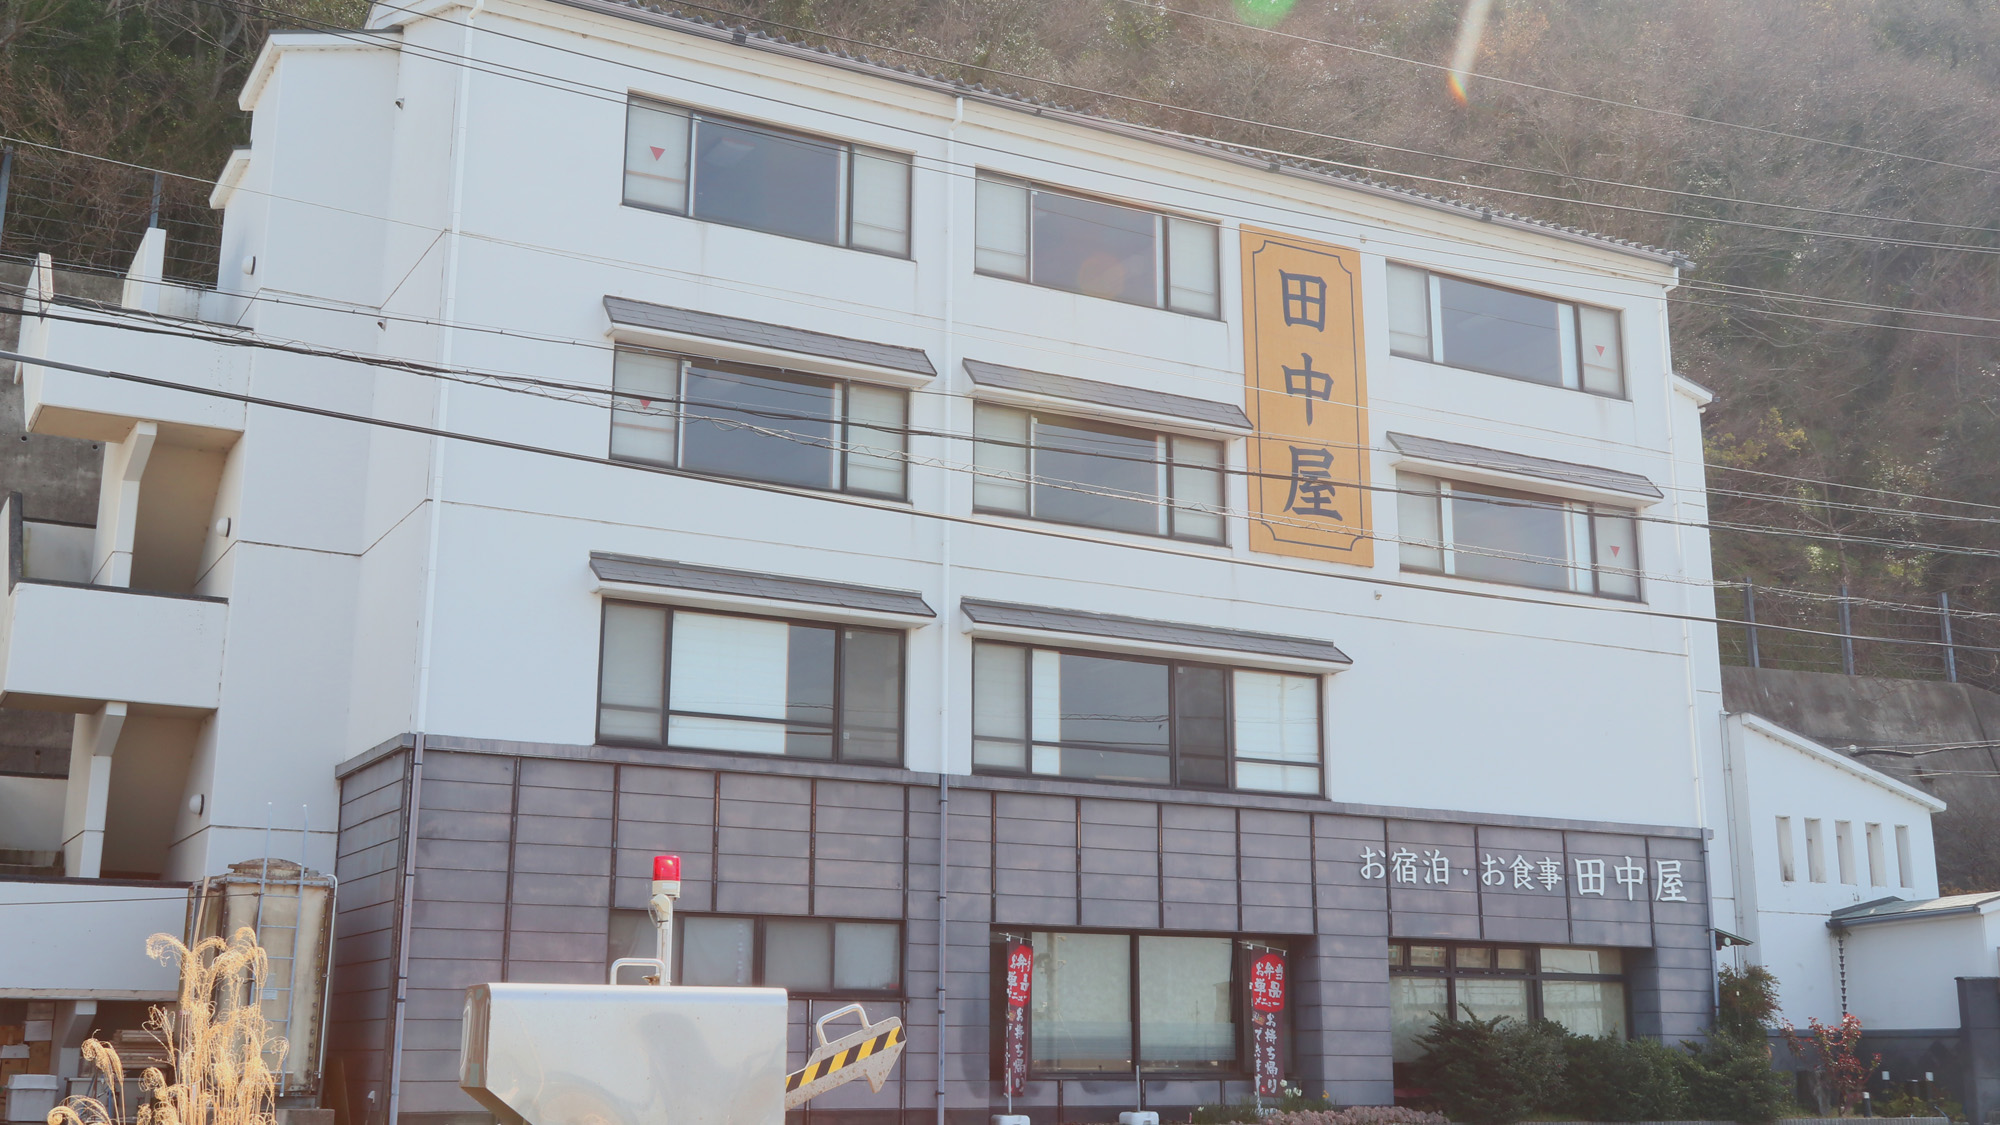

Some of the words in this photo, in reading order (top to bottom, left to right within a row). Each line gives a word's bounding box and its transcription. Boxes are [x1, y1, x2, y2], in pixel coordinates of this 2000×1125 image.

[1279, 269, 1343, 521] 田中屋
[1359, 845, 1563, 891] お宿泊・お食事
[1574, 855, 1688, 902] 田中屋
[1253, 977, 1282, 998] 単品
[1255, 961, 1284, 980] お弁当
[1254, 996, 1281, 1007] メニュー
[1264, 1012, 1279, 1094] お持ち帰り
